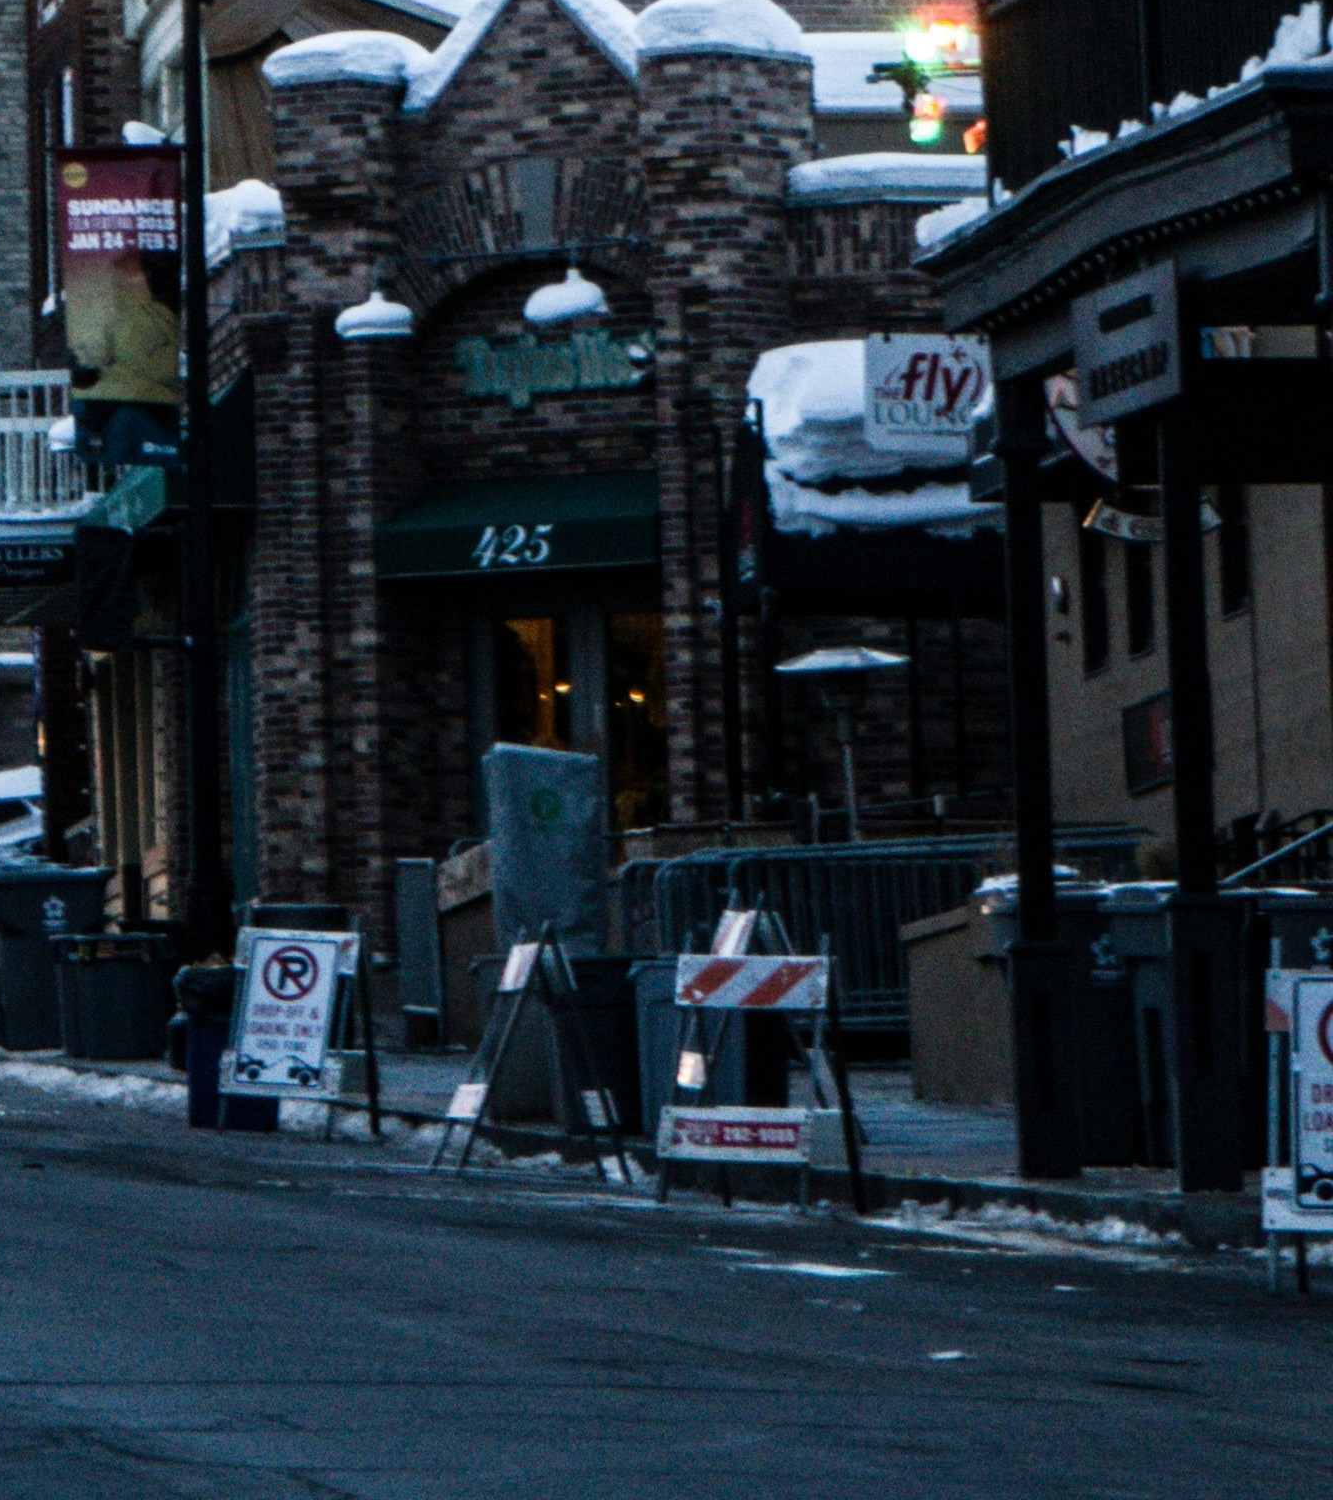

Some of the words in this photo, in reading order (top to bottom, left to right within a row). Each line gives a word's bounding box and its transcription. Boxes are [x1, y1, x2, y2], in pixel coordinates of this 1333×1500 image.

[67, 198, 175, 216] SUNDANCE
[68, 232, 100, 249] JAN
[102, 232, 124, 250] 24
[137, 233, 164, 250] FEB
[900, 351, 972, 417] fly
[472, 524, 554, 568] 425
